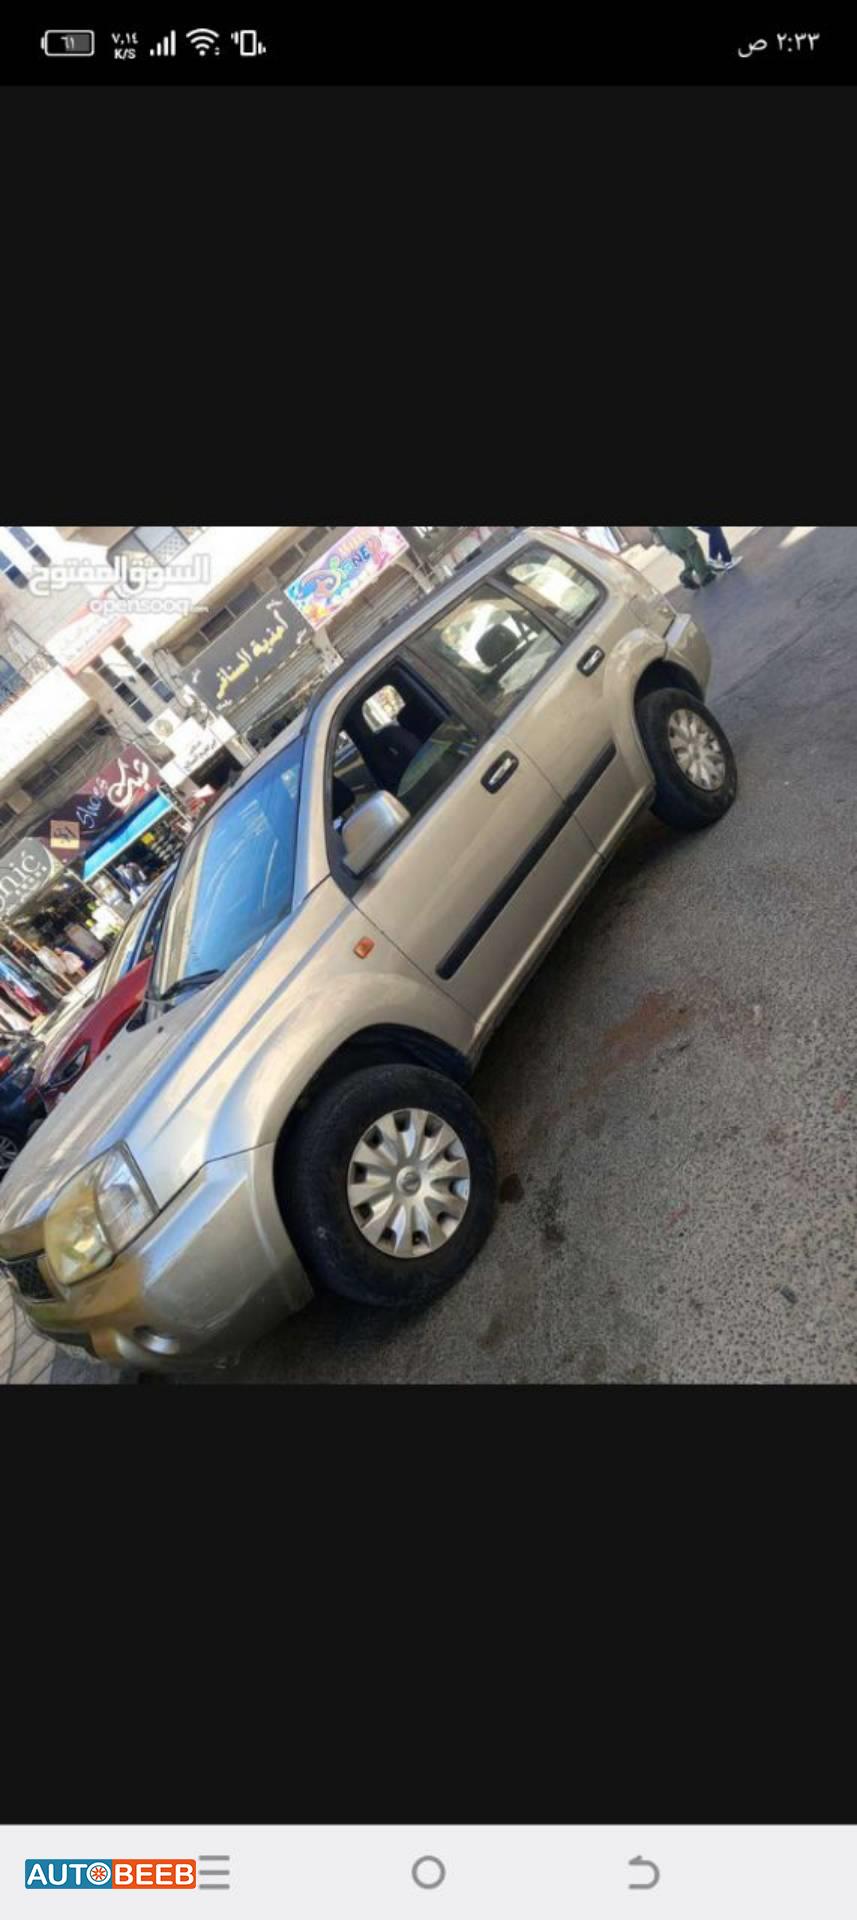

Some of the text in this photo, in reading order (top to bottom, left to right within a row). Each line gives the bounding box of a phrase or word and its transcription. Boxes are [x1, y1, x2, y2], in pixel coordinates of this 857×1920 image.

[114, 48, 136, 59] K/S
[738, 32, 820, 58] ٢:٣٣ ص
